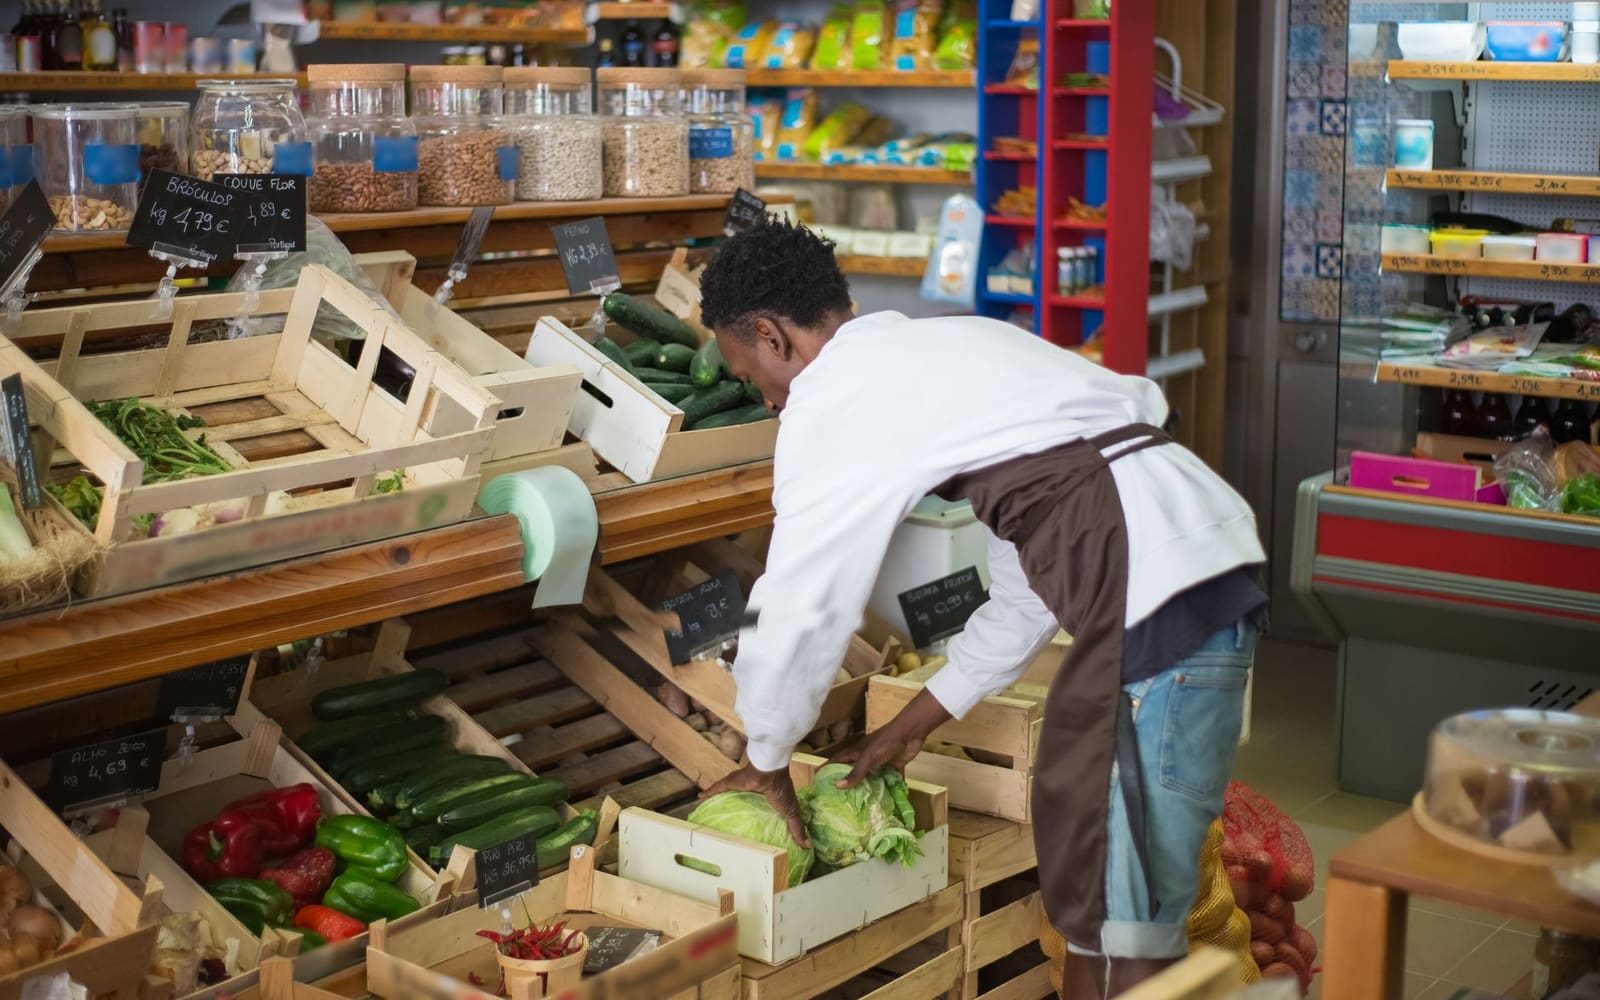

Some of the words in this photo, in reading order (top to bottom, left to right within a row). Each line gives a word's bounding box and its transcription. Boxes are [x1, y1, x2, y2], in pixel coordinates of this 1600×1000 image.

[166, 176, 233, 206] BRÓCULOS
[223, 176, 264, 191] COUVE
[270, 178, 296, 190] FLOR
[150, 202, 168, 226] kg
[216, 220, 230, 233] €
[280, 208, 292, 220] €
[71, 747, 107, 764] ALHO
[88, 759, 127, 781] 4,69
